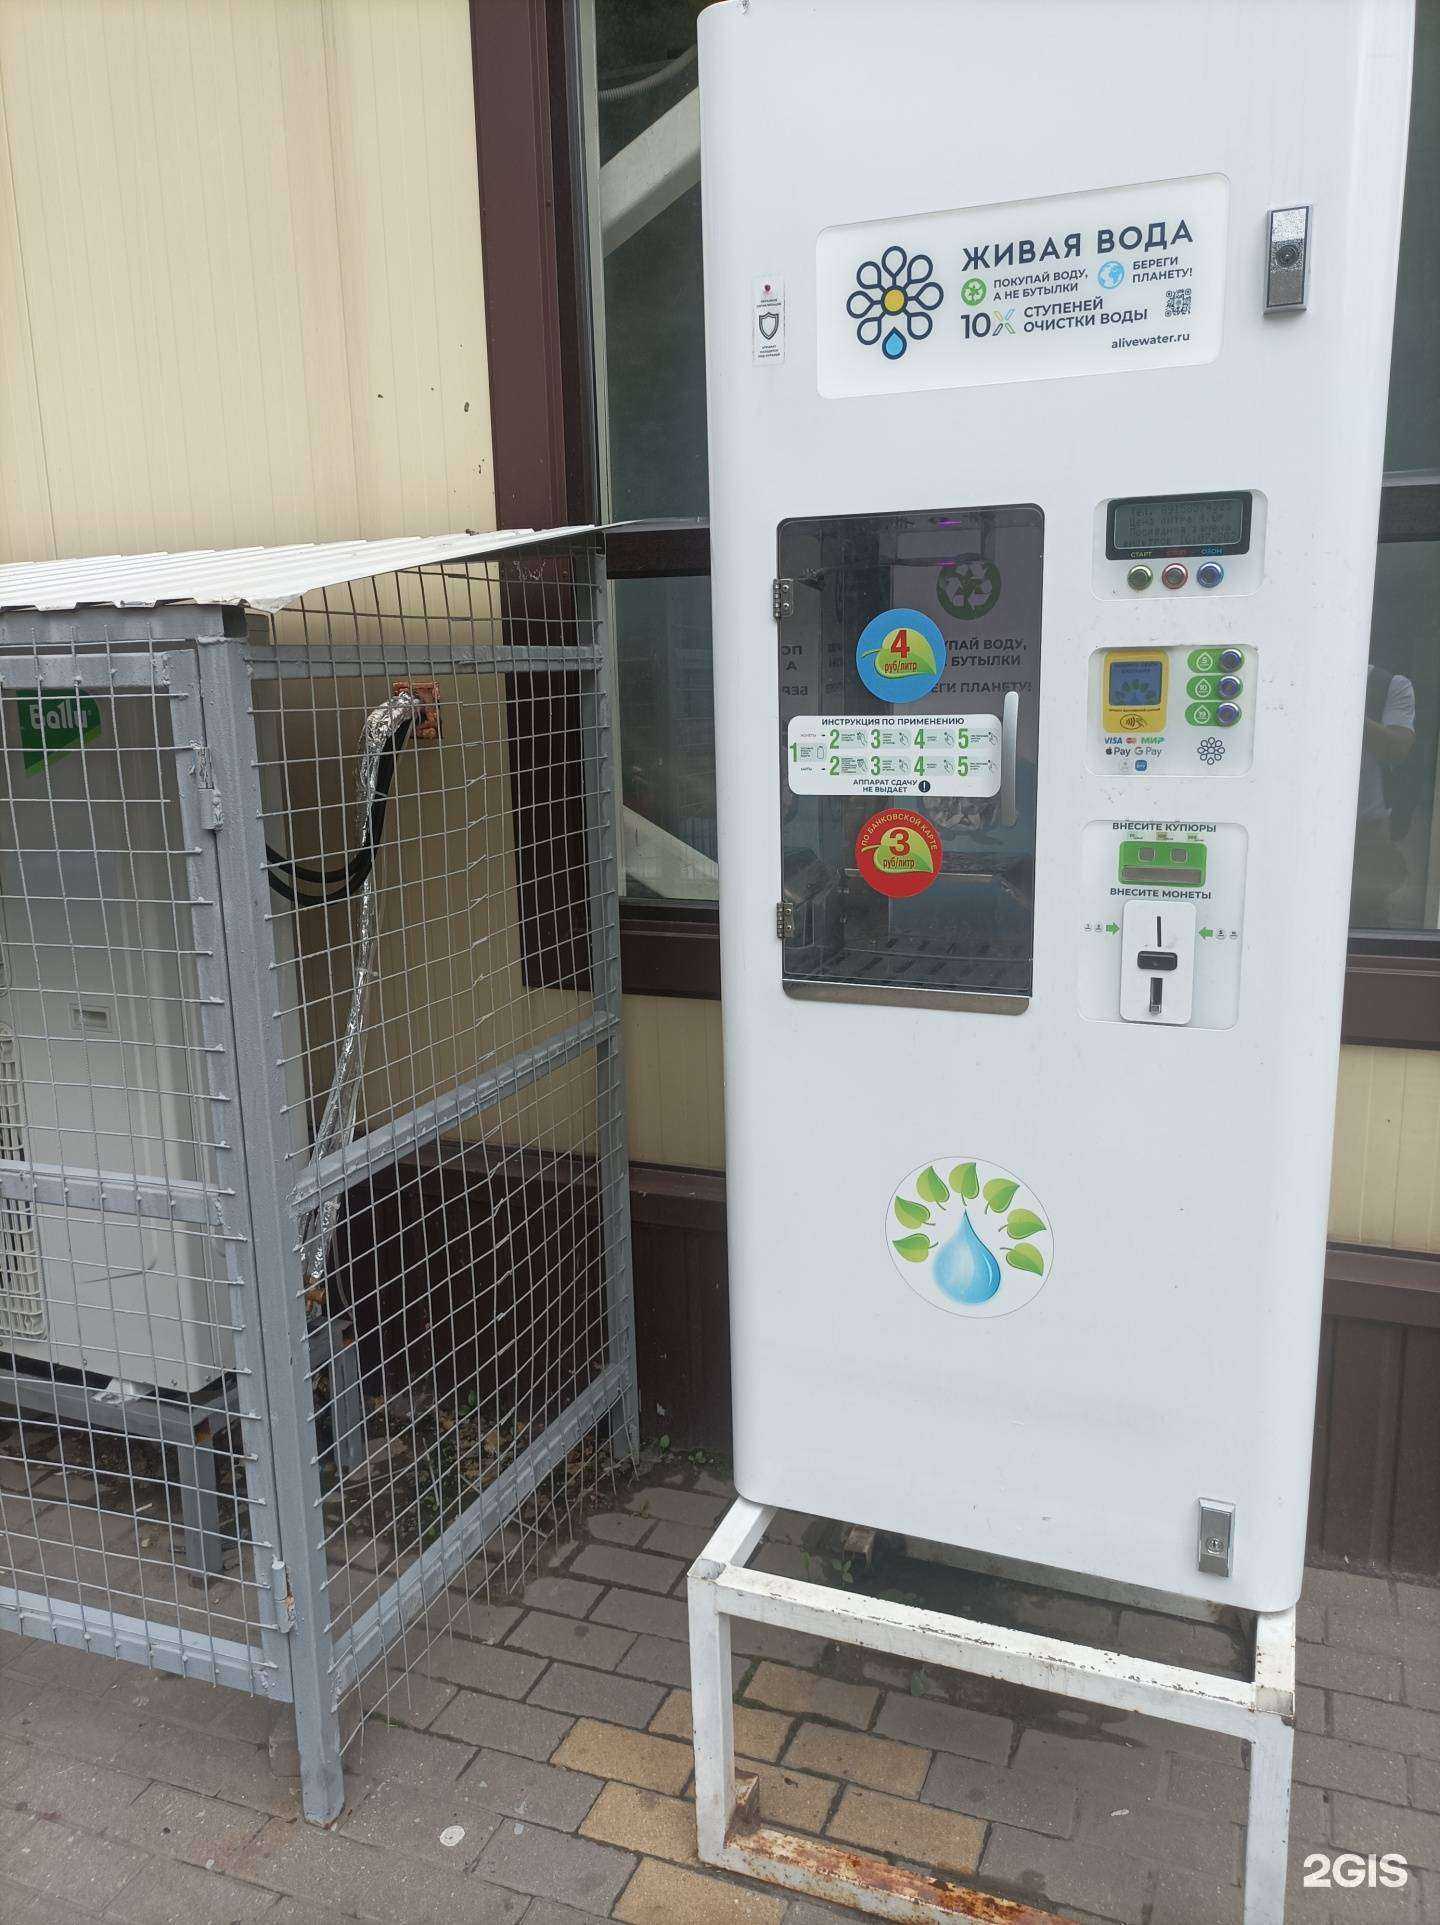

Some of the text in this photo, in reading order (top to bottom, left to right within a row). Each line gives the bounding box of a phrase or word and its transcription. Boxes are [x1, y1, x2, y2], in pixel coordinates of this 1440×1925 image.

[961, 219, 1193, 272] ЖИВАЯ ВОДА
[1132, 256, 1179, 271] БЕРЕГИ
[994, 268, 1088, 289] ПОКУПАЙ ВОДУ,
[1132, 267, 1194, 284] ПЛАНЕТУ!
[993, 283, 1079, 301] А НЕ БУТЫЛКИ
[1024, 297, 1104, 319] СТУПЕНЕЙ
[1023, 308, 1148, 333] ОЧИСТКИ ВОДЫ
[1111, 332, 1191, 349] alivewater.ru
[890, 629, 911, 659] 4
[983, 638, 1027, 651] ВОДУ,
[884, 660, 918, 674] руб/литр
[951, 655, 1021, 667] БУТЫЛКИ
[821, 717, 965, 727] ИНСТРУКЦИЯ ПО ПРИМЕНЕНИЮ
[829, 728, 840, 749] 2
[870, 728, 881, 749] 3
[914, 728, 925, 749] 4
[958, 728, 969, 749] 5
[1104, 736, 1123, 745] VISA
[789, 742, 798, 763] 1
[1113, 746, 1131, 758] Pay
[1146, 746, 1162, 758] Pay
[829, 756, 840, 776] 2
[870, 756, 881, 776] 3
[914, 756, 925, 776] 4
[957, 756, 969, 776] 5
[874, 786, 908, 794] ВЫДАЕТ
[891, 779, 918, 787] СДАЧУ
[867, 813, 921, 834] БАНКОВСКОЙ
[920, 825, 938, 851] КАРТЕ
[1112, 822, 1216, 833] ВНЕСИТЕ КУПЮРЫ
[889, 828, 911, 856] 3
[1110, 887, 1212, 900] ВНЕСИТЕ МОНЕТЫ
